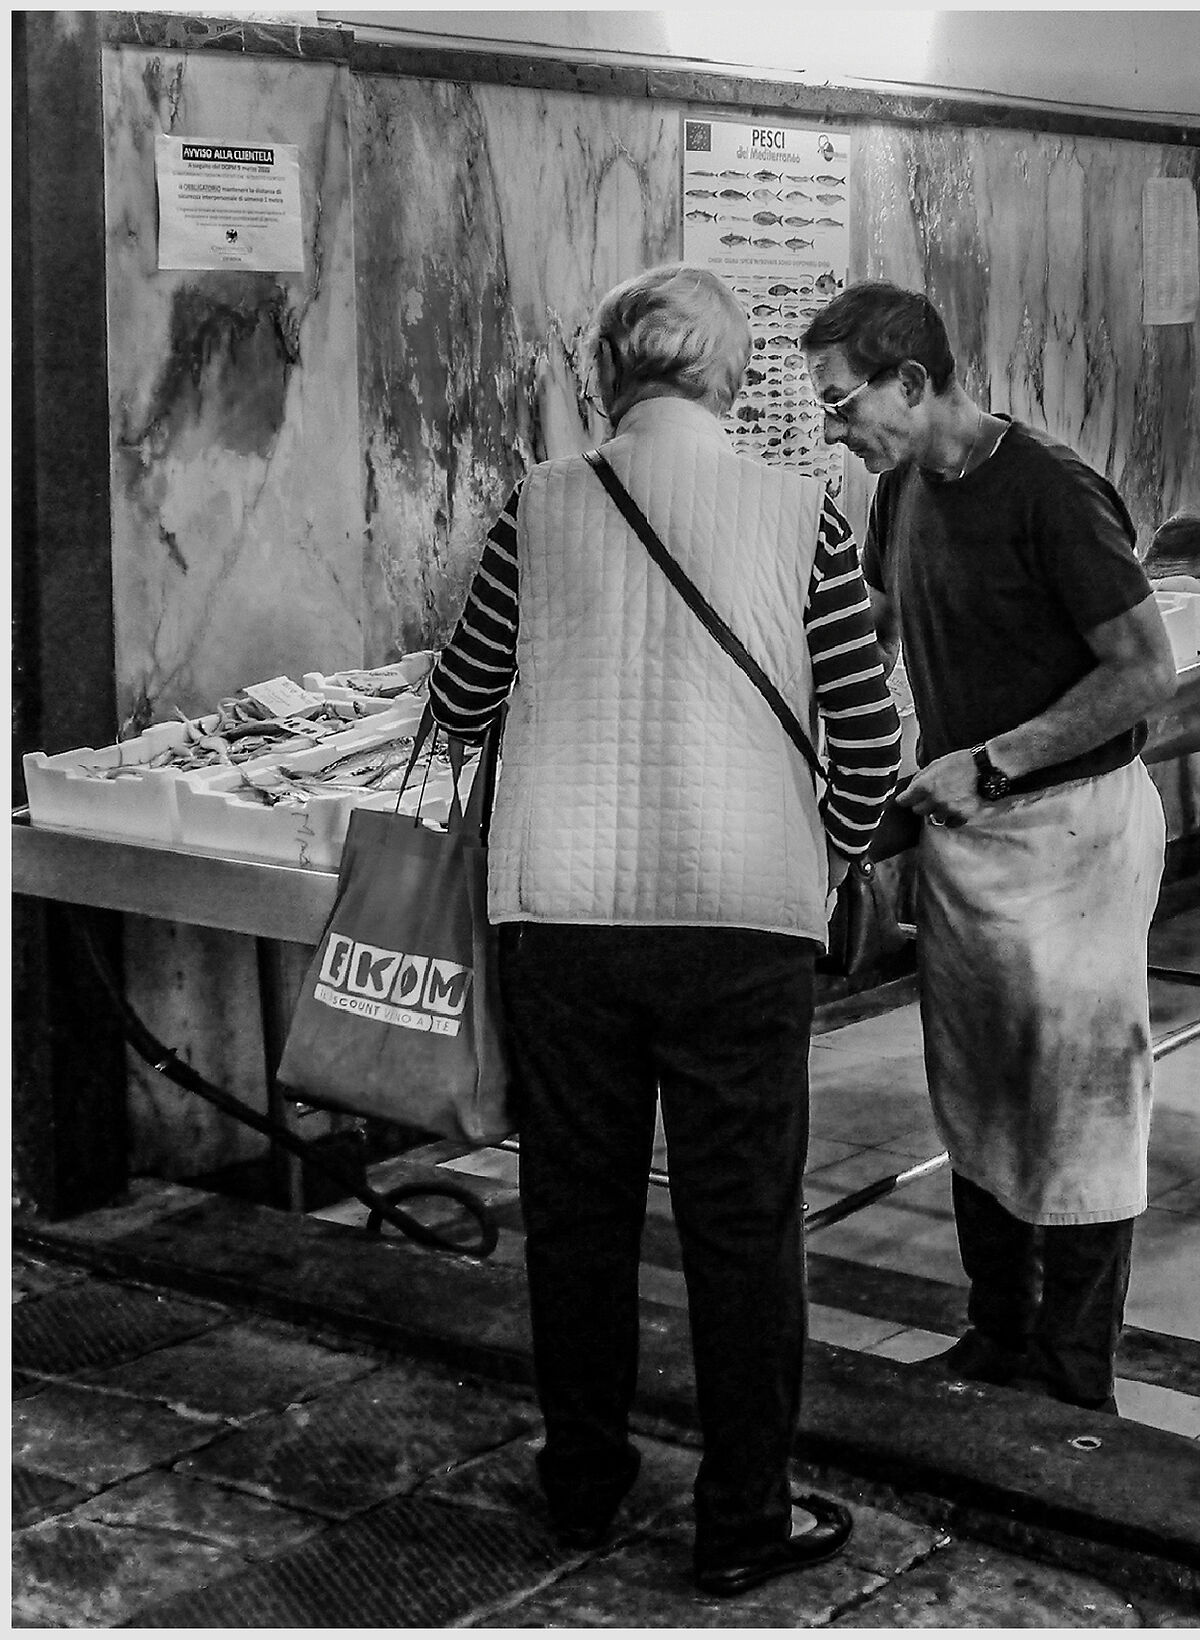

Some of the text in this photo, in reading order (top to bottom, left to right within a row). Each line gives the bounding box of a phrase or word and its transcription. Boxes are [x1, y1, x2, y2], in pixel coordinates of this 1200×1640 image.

[752, 129, 785, 149] PESCI
[183, 147, 273, 162] AVVISO ALLA CLIENTELA
